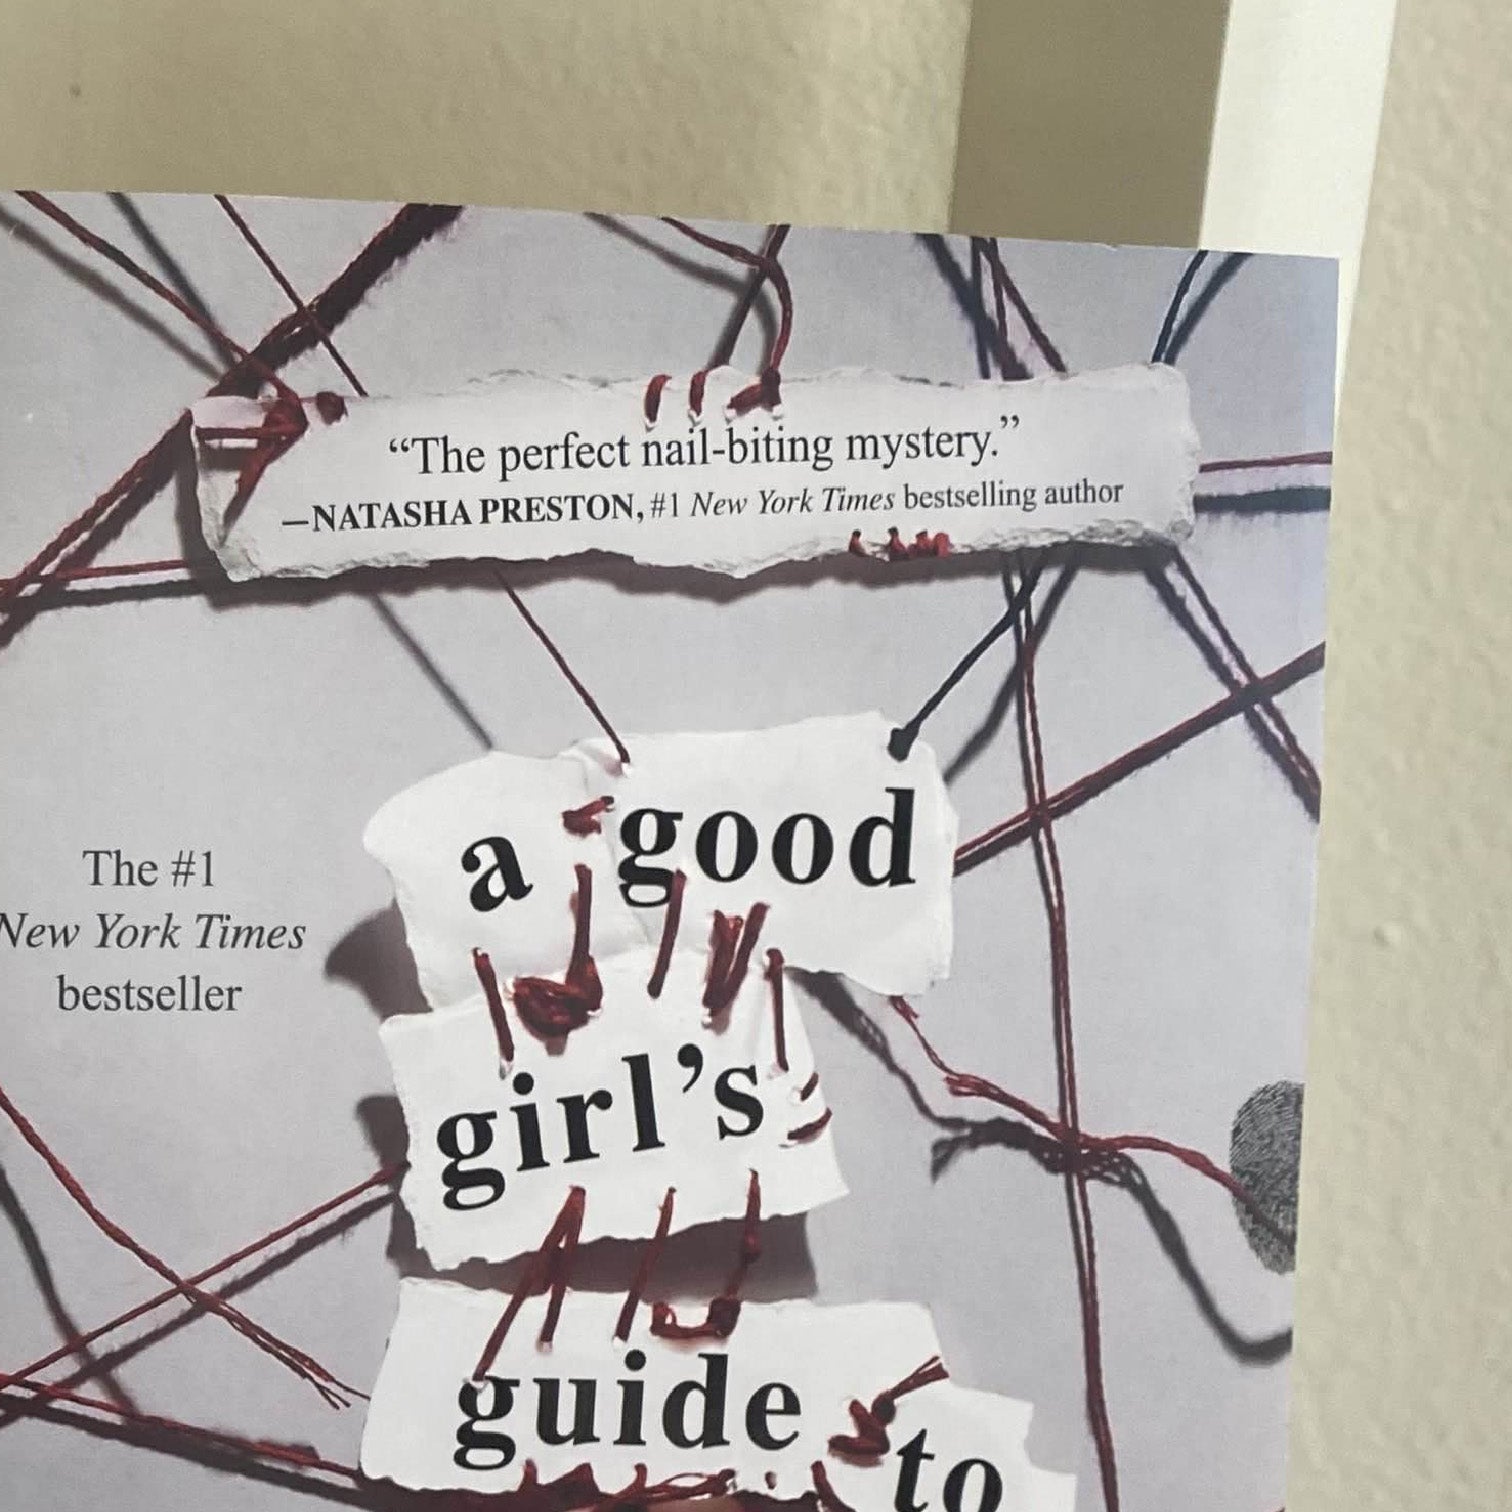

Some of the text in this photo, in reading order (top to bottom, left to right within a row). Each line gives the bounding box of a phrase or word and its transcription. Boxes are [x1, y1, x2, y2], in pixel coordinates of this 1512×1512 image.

[388, 414, 1021, 482] “The perfect nail-biting mystery.”
[478, 492, 644, 526] PRESTON,
[649, 491, 680, 519] #1
[690, 490, 747, 517] New
[758, 487, 814, 515] York
[821, 485, 895, 512] Times
[903, 481, 1037, 512] bestselling
[1044, 477, 1124, 505] author
[82, 849, 215, 888] The #1
[460, 786, 917, 913] a good
[94, 912, 182, 949] York
[195, 913, 307, 949] Times
[55, 974, 243, 1012] bestseller
[435, 1042, 766, 1212] girl’s
[452, 1348, 803, 1471] guide
